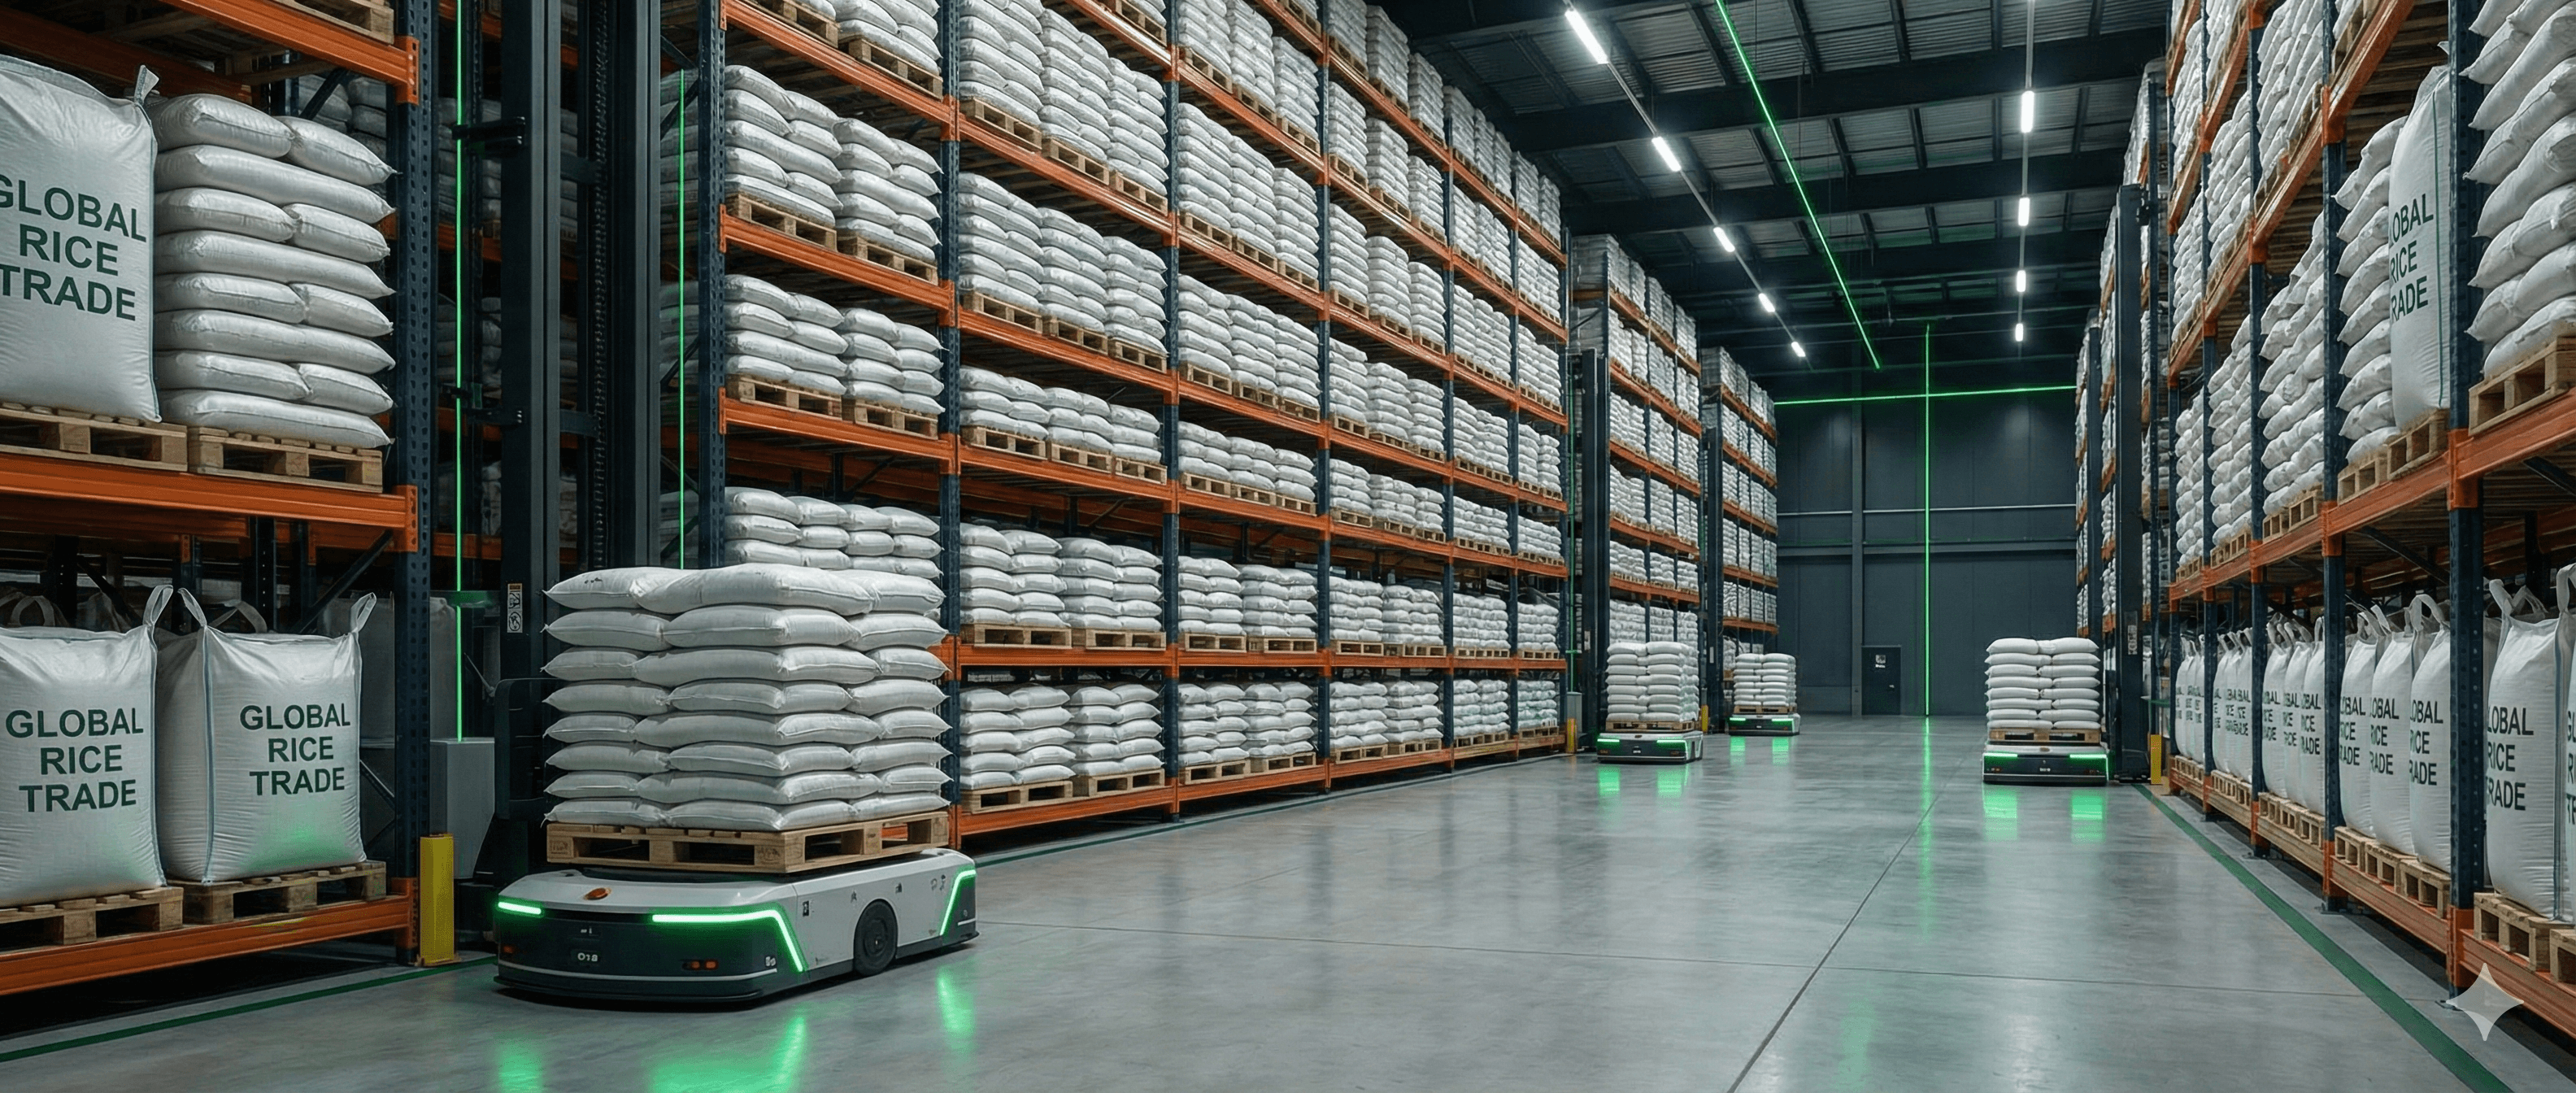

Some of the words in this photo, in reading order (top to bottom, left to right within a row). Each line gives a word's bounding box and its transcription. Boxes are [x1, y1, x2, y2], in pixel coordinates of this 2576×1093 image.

[2392, 193, 2435, 243] OBAL
[20, 223, 119, 277] RICE
[2391, 275, 2429, 322] RADE
[5, 708, 145, 738] GLOBAL
[239, 703, 351, 730] GLOBAL
[2409, 699, 2444, 724] OBAL
[2487, 705, 2535, 736] OBAL
[40, 744, 124, 775] RICE
[268, 735, 334, 763] RICE
[2487, 741, 2516, 773] RICE
[18, 779, 137, 812] TRADE
[249, 767, 346, 796] TRADE
[2486, 775, 2526, 812] RADE
